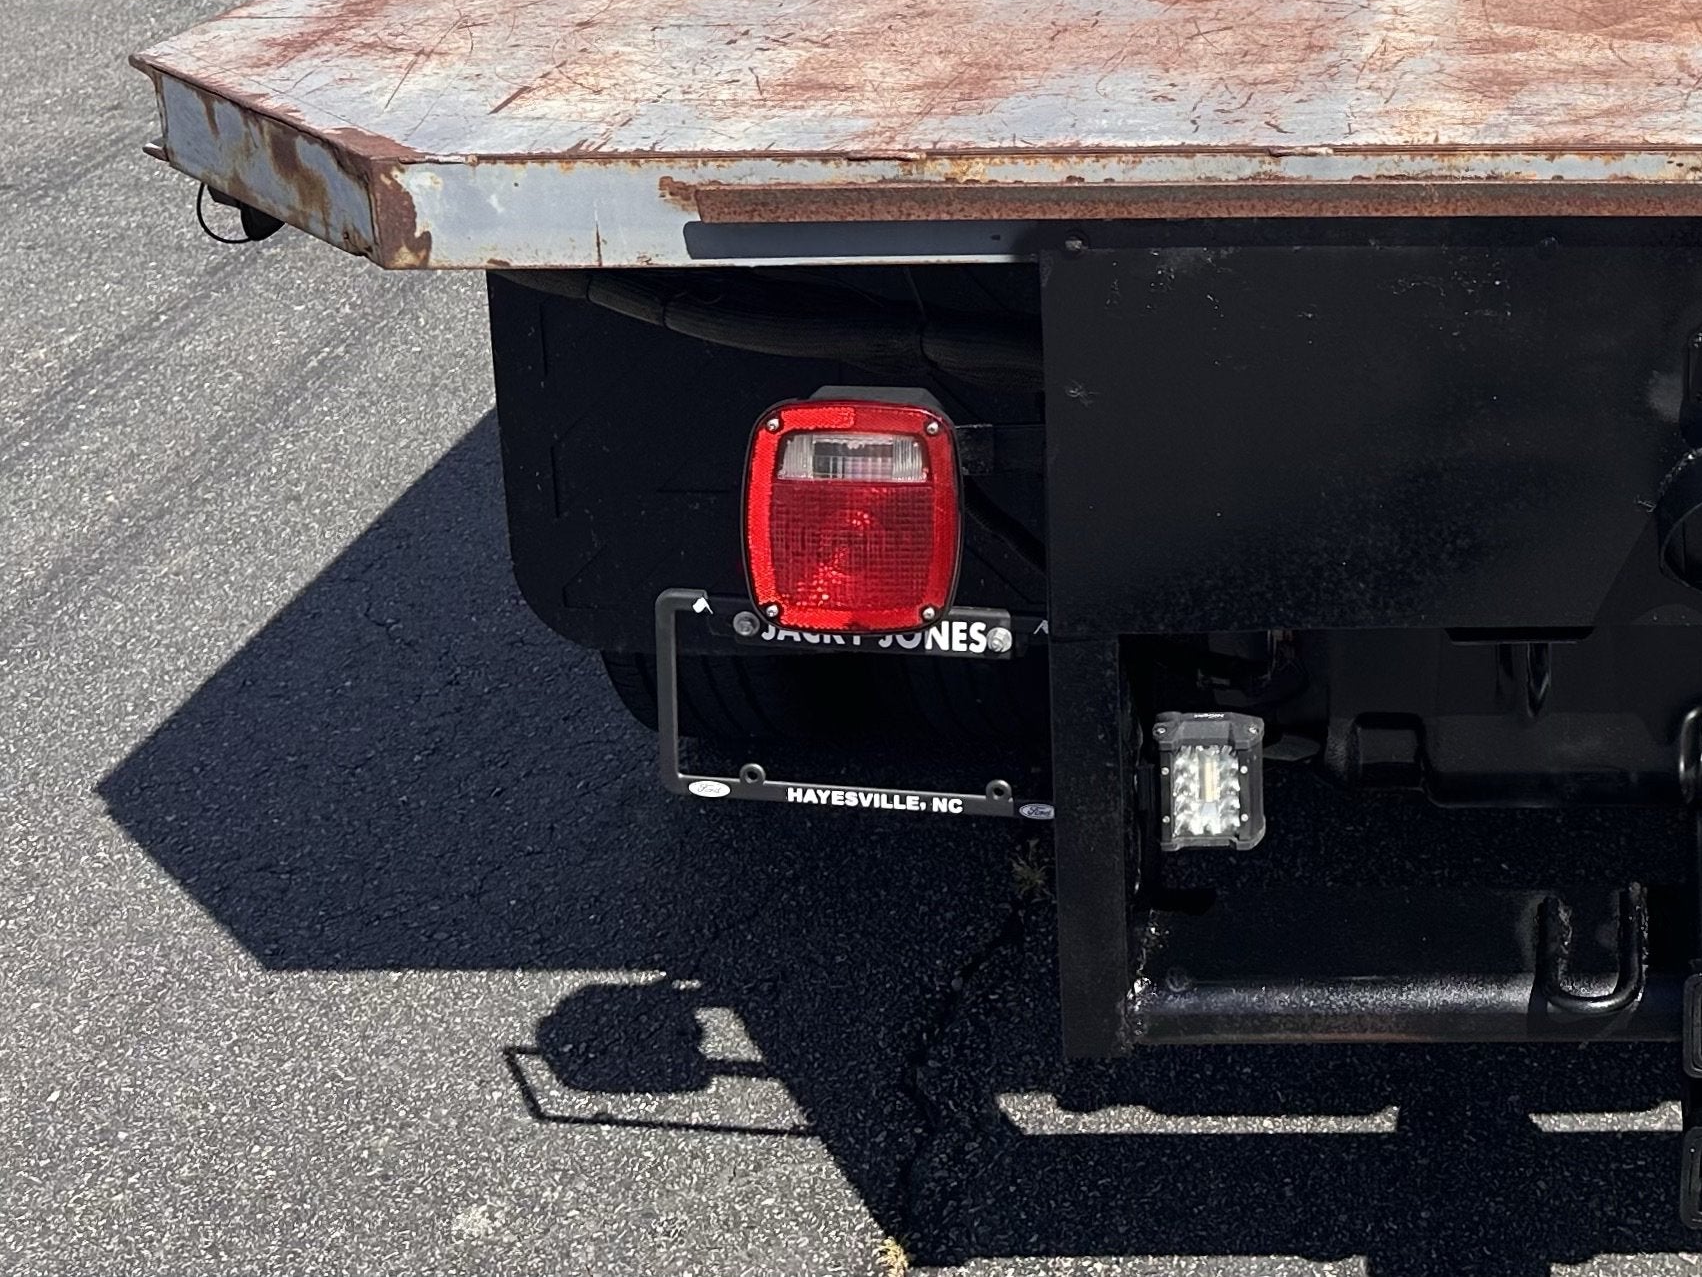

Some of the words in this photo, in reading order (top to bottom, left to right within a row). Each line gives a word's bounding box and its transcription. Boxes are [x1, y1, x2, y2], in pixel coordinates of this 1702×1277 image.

[878, 621, 987, 653] JONES
[787, 787, 927, 811] HAYESVILLE,
[932, 797, 963, 814] NC
